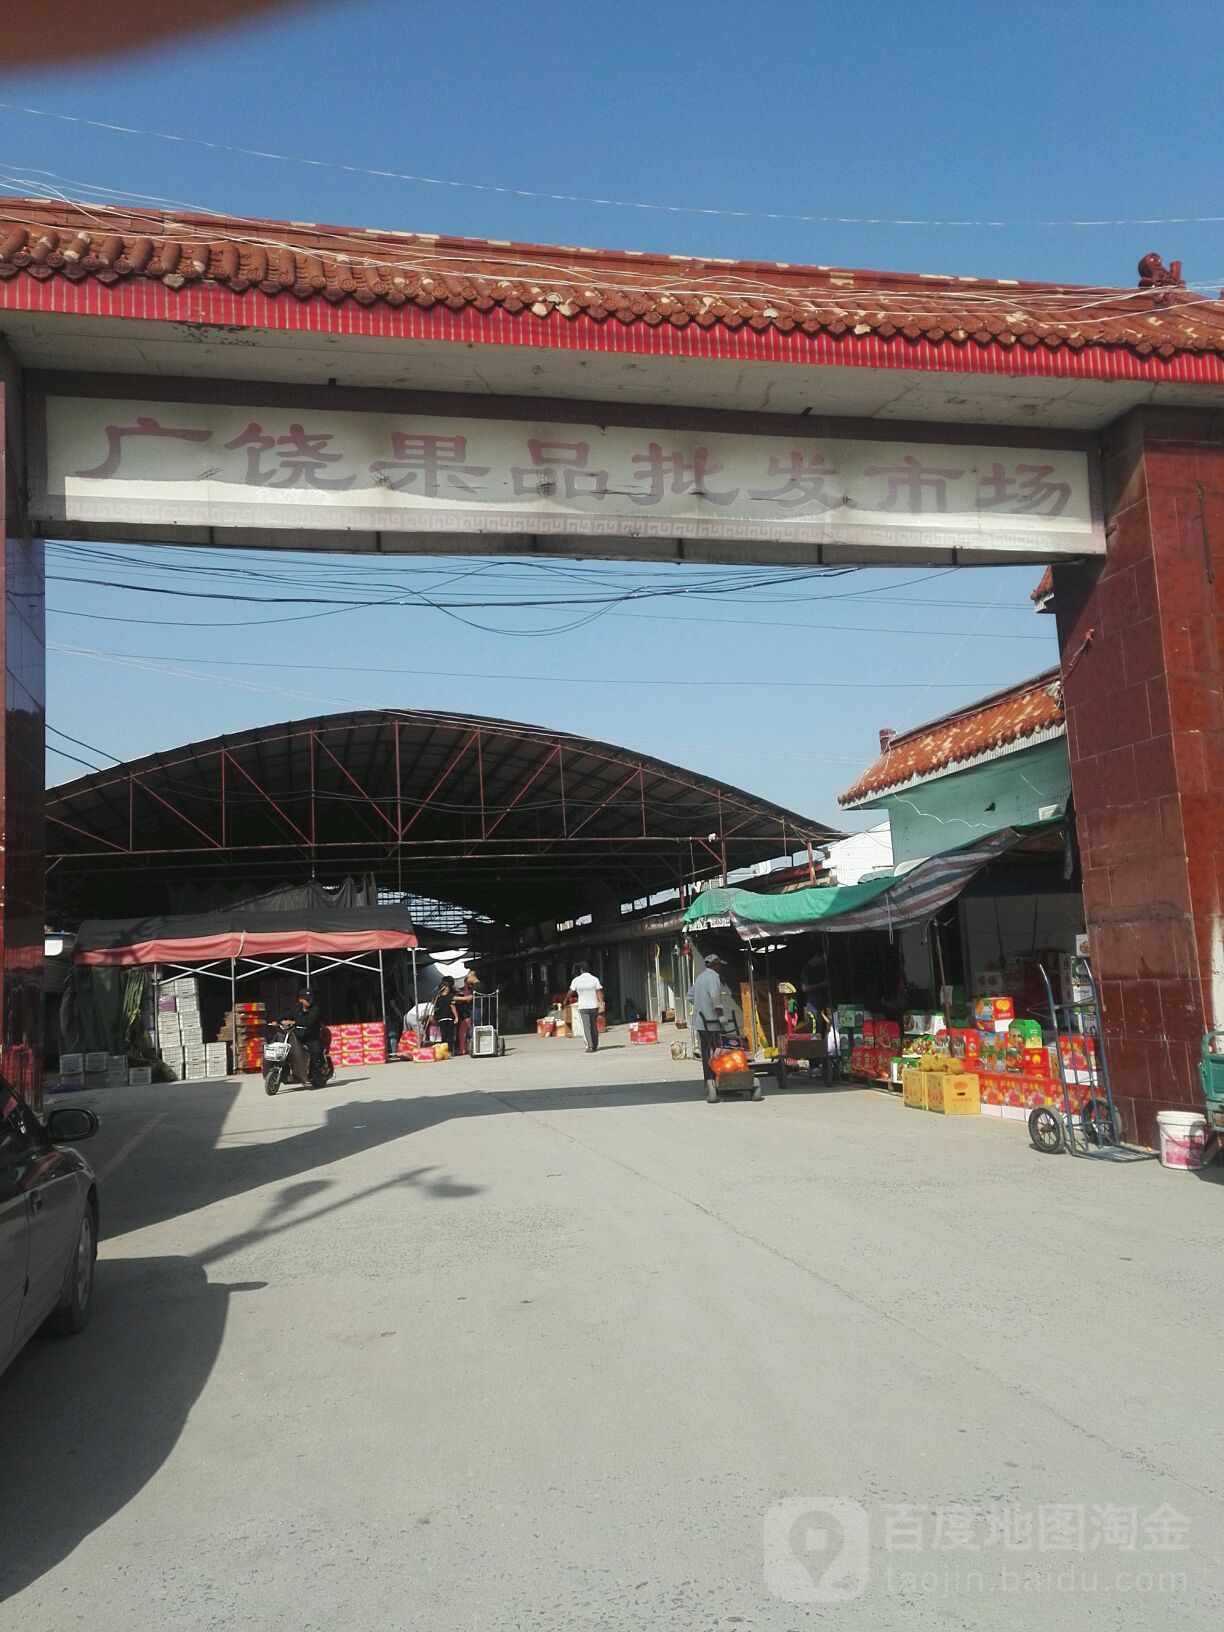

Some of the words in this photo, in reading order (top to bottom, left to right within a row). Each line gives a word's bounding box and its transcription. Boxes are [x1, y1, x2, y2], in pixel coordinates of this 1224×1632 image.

[75, 417, 1072, 521] 广饶果品批发市场
